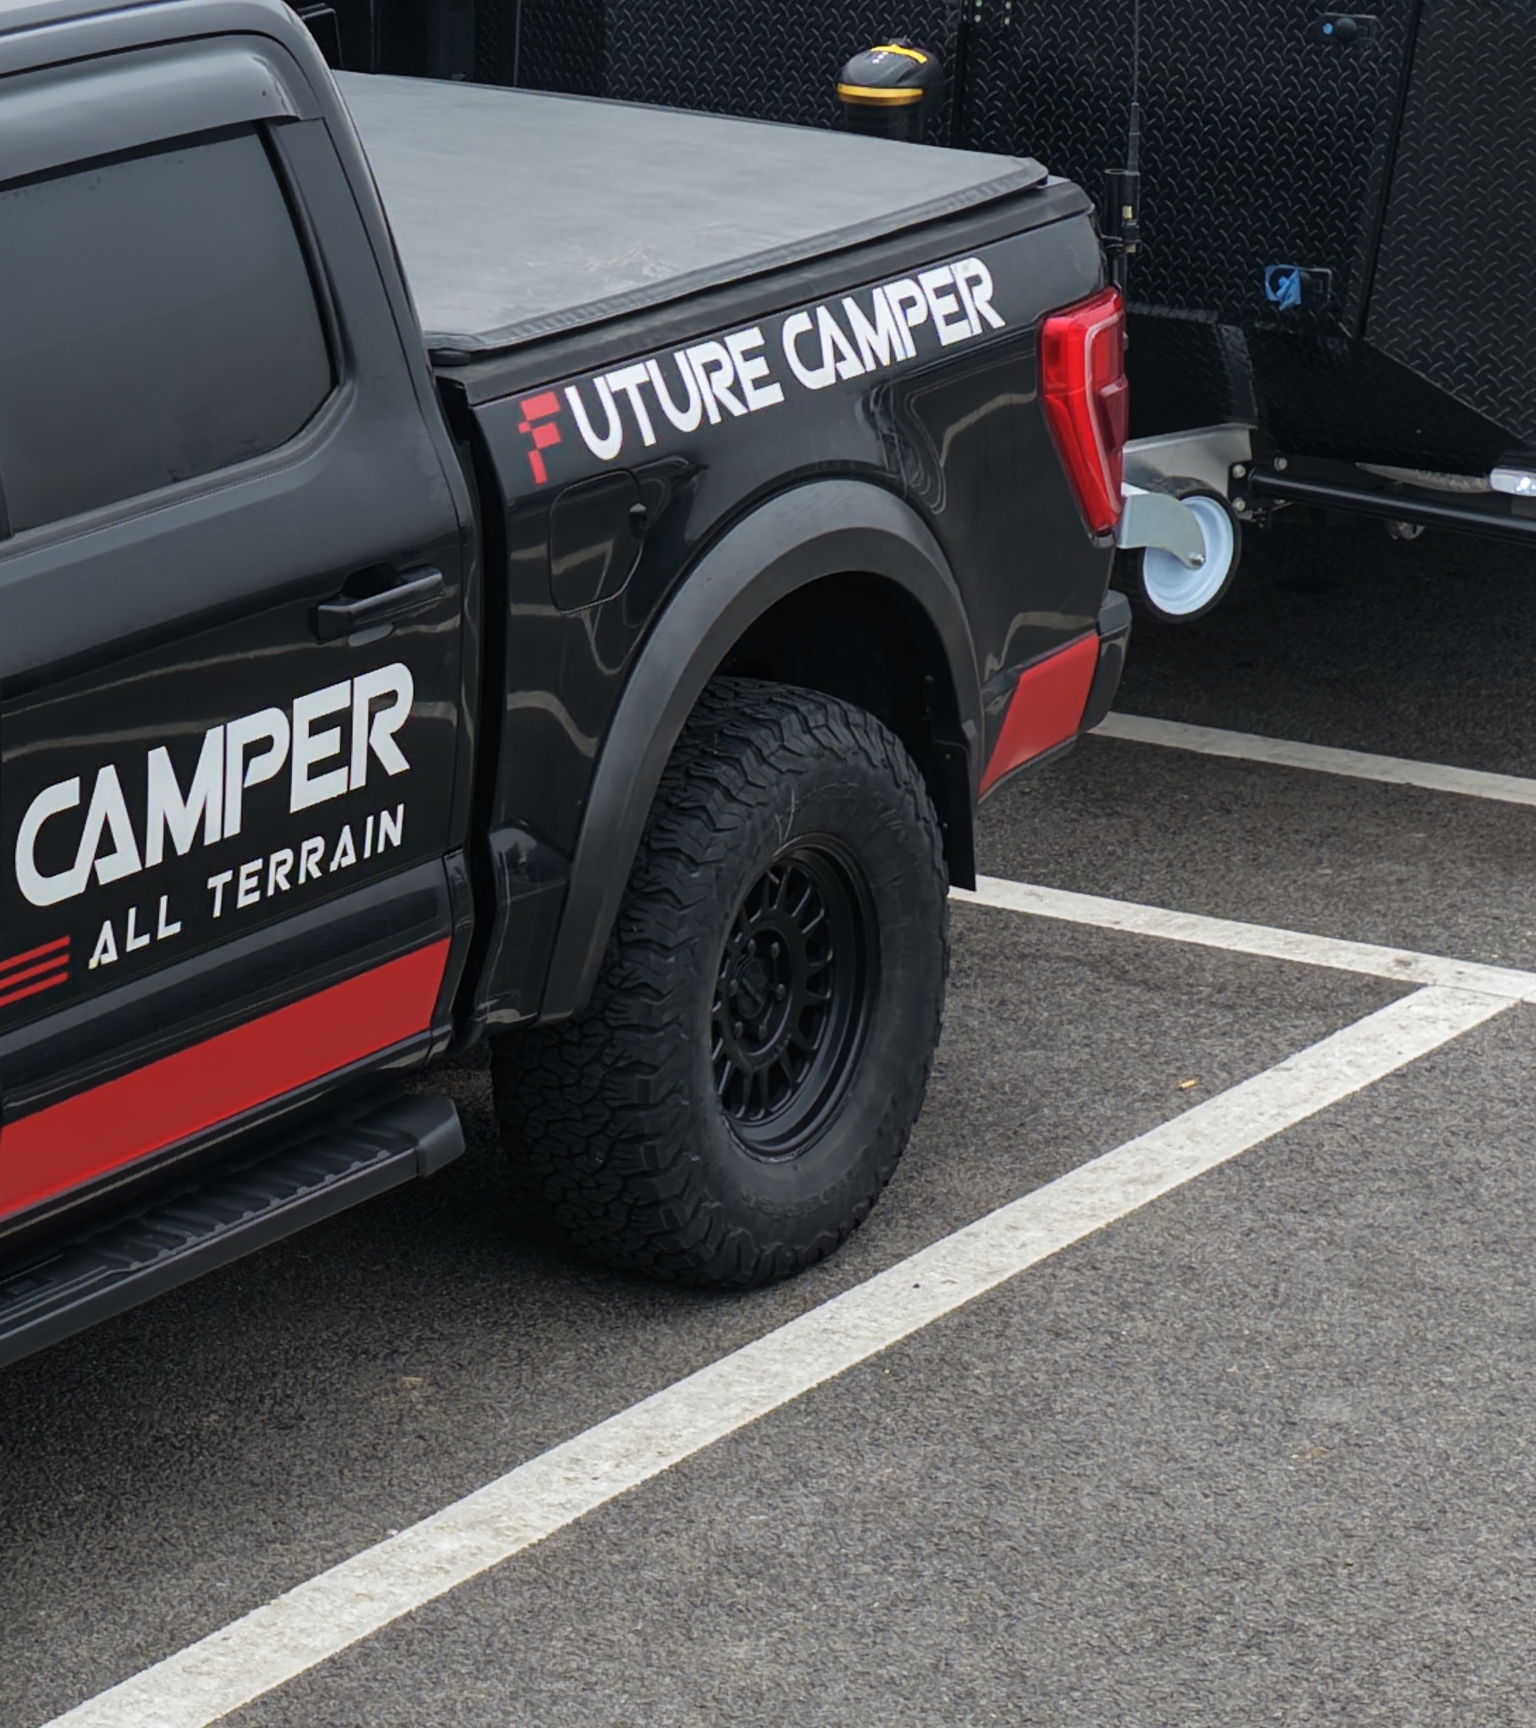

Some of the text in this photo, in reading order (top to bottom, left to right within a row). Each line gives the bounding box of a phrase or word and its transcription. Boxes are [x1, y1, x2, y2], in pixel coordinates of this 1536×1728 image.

[518, 257, 1006, 485] FUTURE CAMPER
[14, 661, 415, 908] CAMPER
[87, 803, 406, 970] ALL TERRAIN
